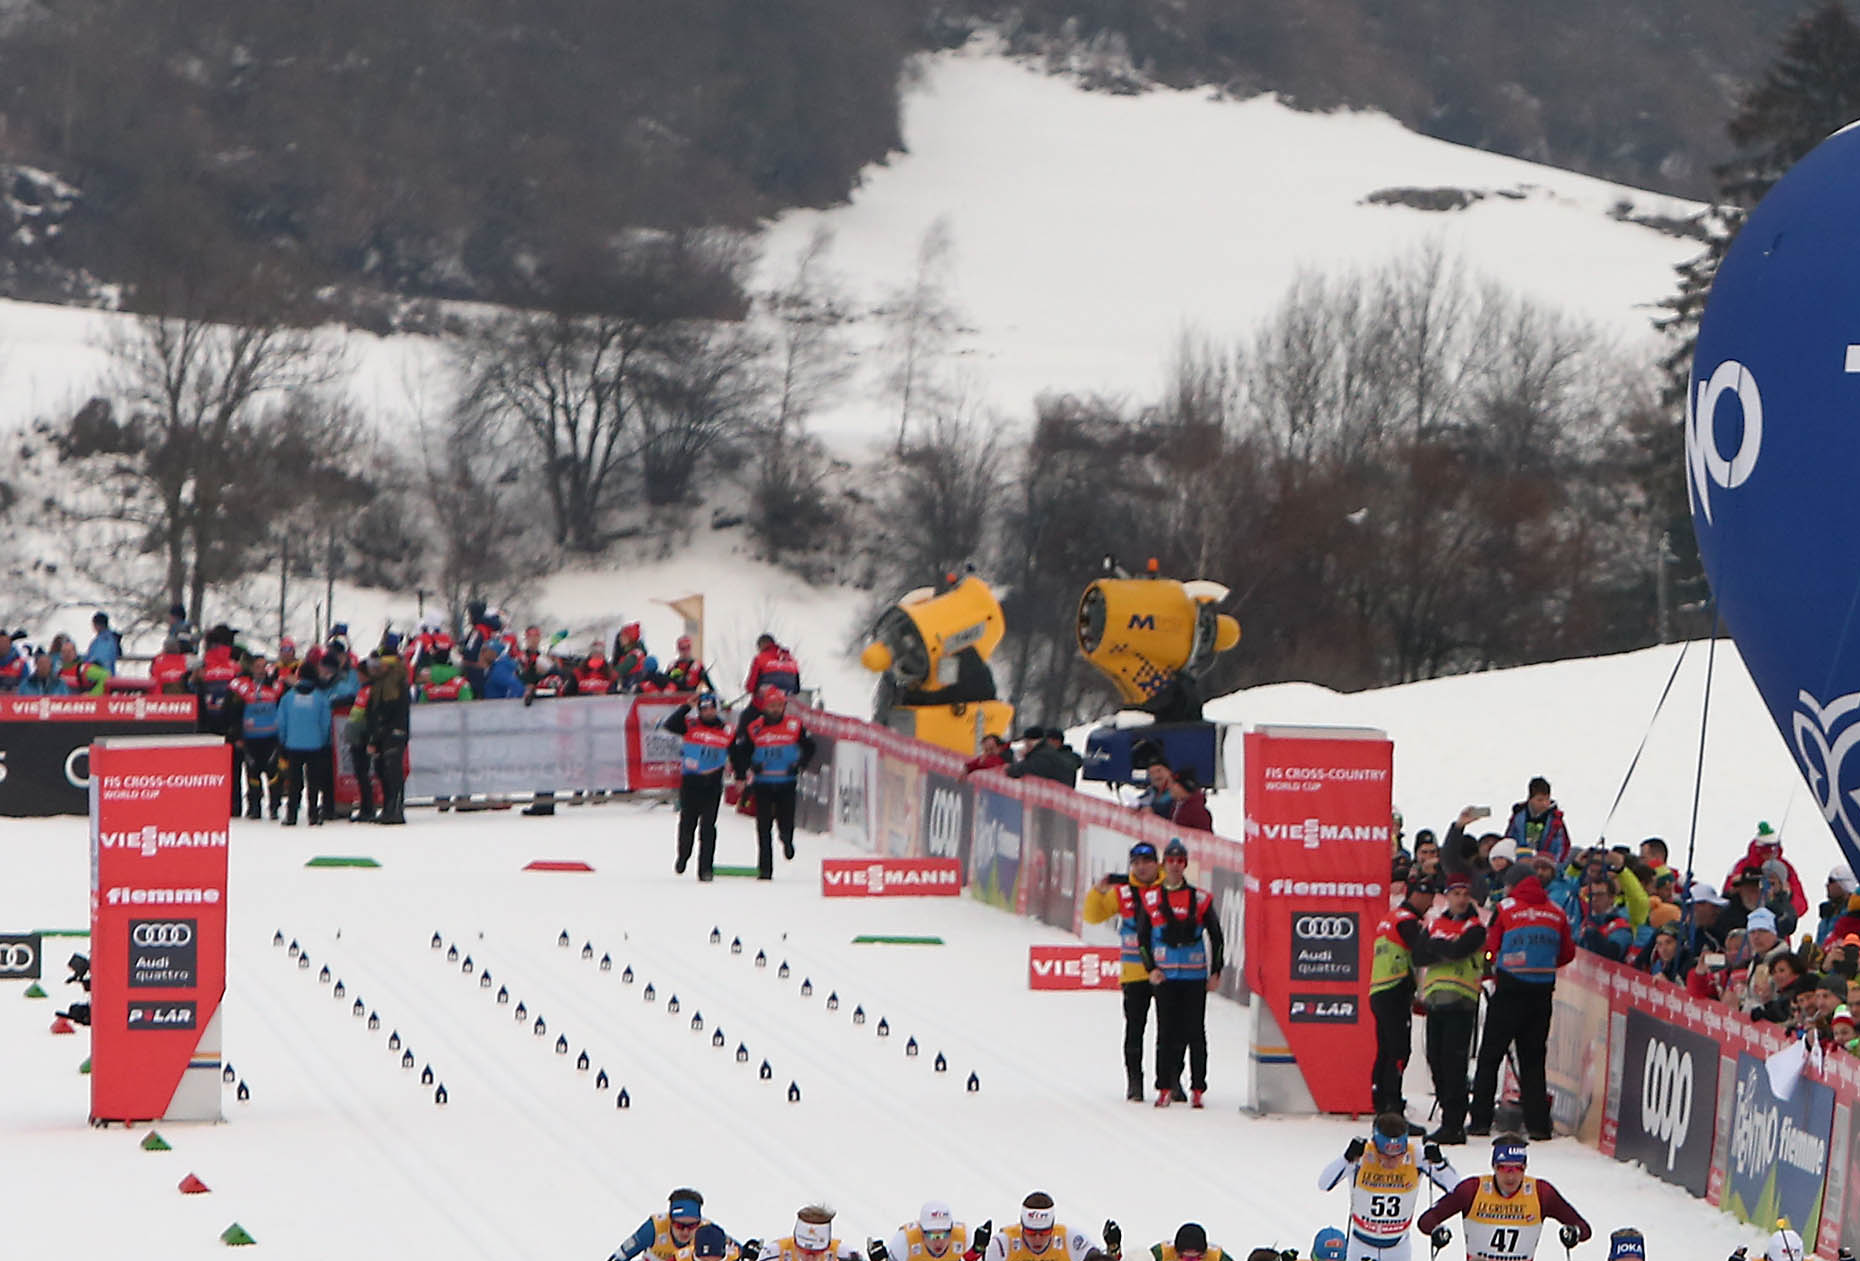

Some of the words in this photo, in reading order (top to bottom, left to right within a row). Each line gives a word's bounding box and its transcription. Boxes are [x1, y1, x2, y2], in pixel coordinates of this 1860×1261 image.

[11, 698, 97, 720] VIESSMANN
[108, 697, 192, 720] VIESSMANN
[104, 776, 120, 787] FIS
[123, 775, 225, 786] CROSS-COUNTRY
[1265, 768, 1283, 779] FIS
[1285, 768, 1387, 781] CROSS-COUNTRY
[104, 790, 139, 799] WORLD
[140, 790, 161, 798] CUP
[1265, 782, 1300, 790] WORLD
[1302, 782, 1322, 791] CUP
[100, 826, 226, 856] VIESSMANN
[1263, 818, 1388, 848] VIESSMANN
[824, 865, 957, 894] VIESSMANN
[1269, 878, 1382, 896] fiemme
[106, 887, 220, 904] fiemme
[136, 956, 170, 969] Audi
[1298, 950, 1332, 961] Audi
[135, 970, 188, 982] quattro
[1031, 953, 1121, 987] VIESSM
[1298, 962, 1351, 974] quattro
[1641, 1036, 1695, 1172] coop
[1778, 1116, 1825, 1176] fiemme
[1371, 1196, 1400, 1217] 53
[1490, 1229, 1519, 1252] 47
